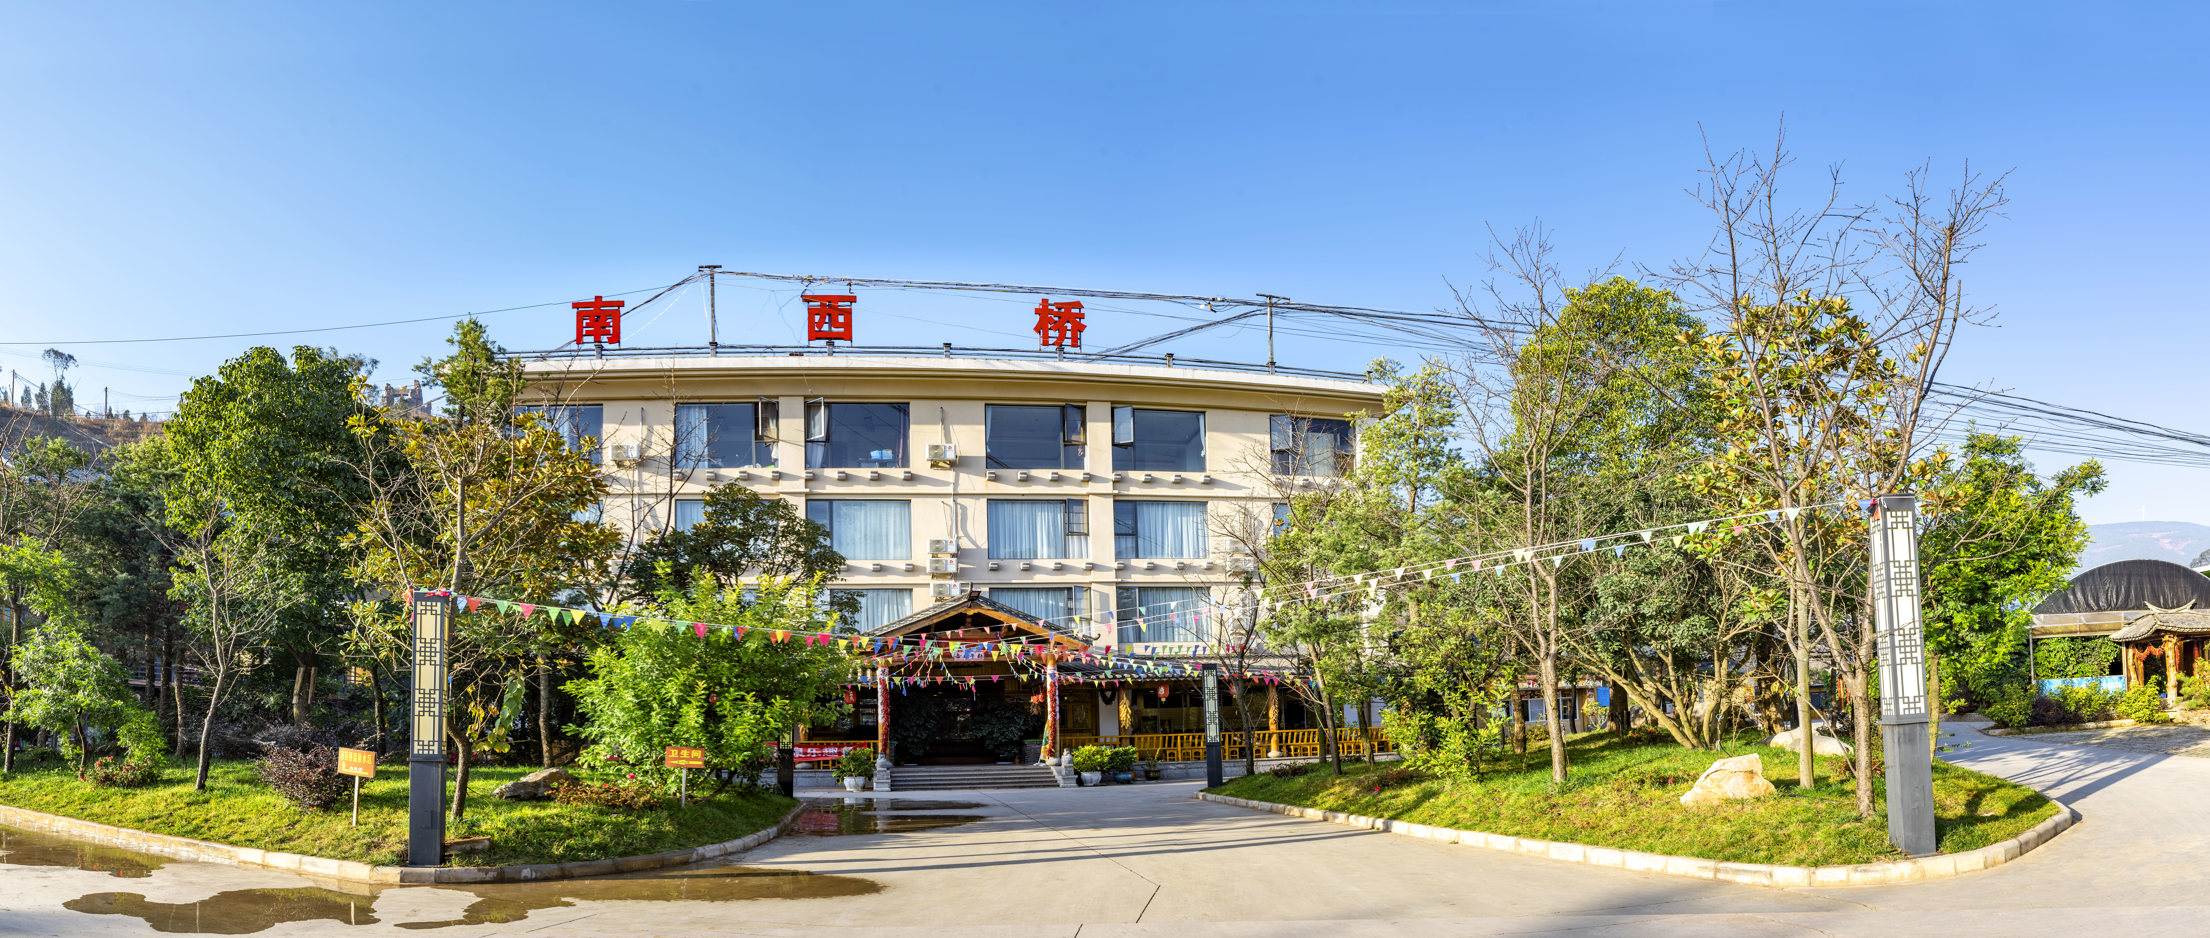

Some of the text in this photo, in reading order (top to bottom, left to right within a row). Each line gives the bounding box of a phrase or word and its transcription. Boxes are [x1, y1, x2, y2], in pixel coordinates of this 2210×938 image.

[572, 295, 1086, 346] 南西桥
[668, 749, 702, 759] 卫生间
